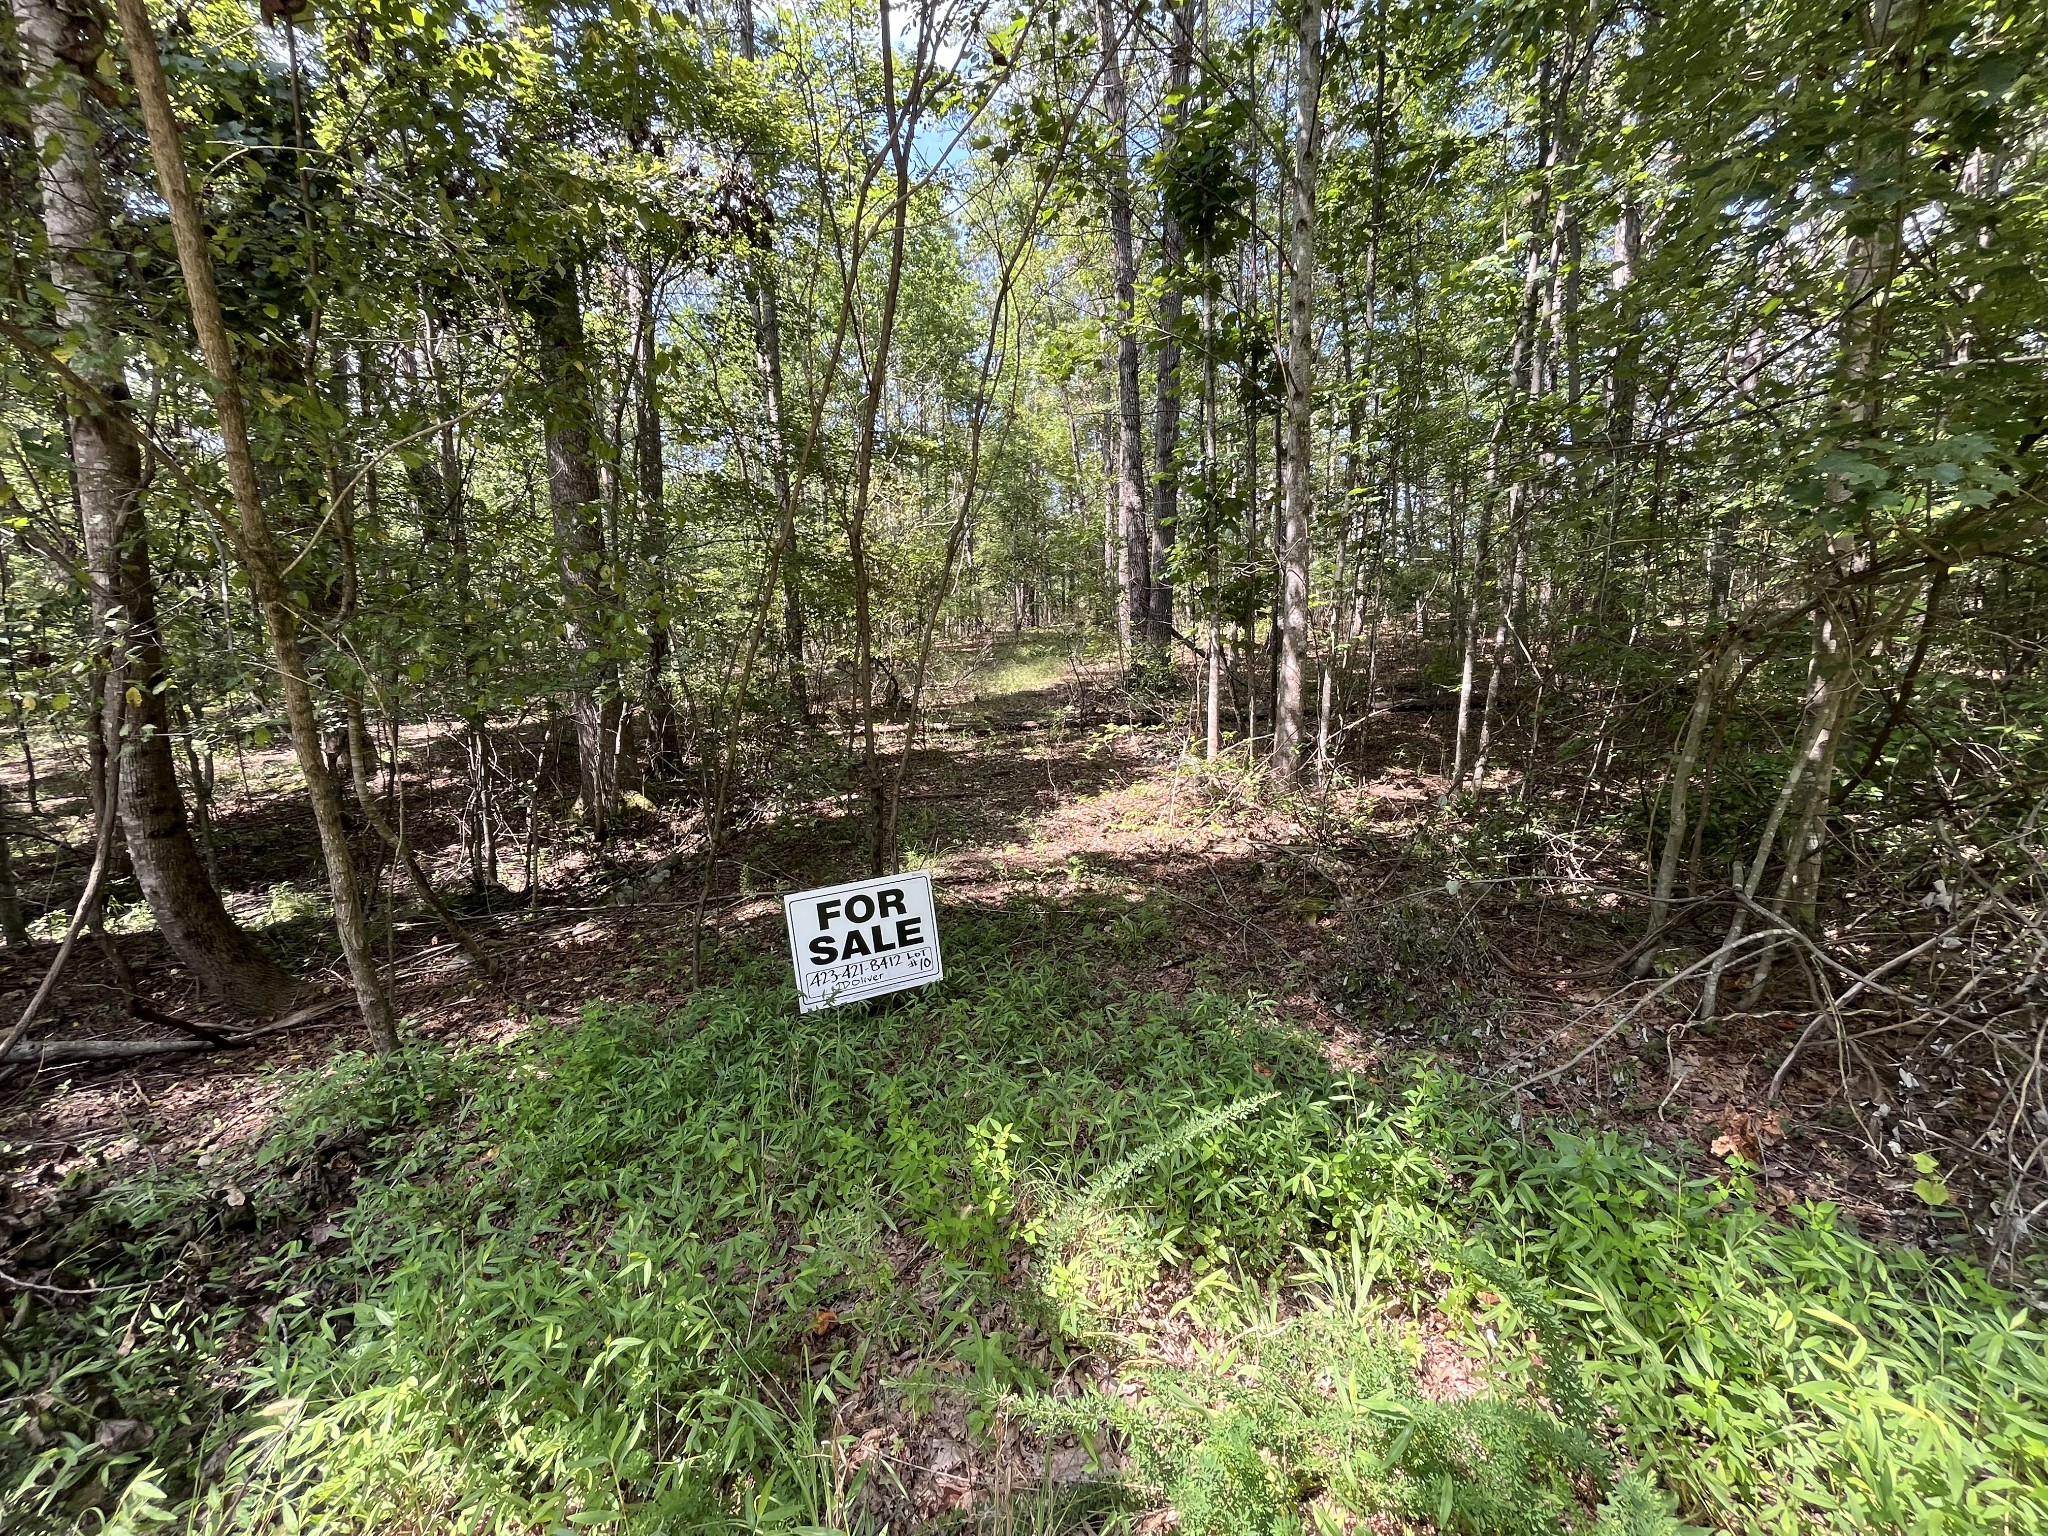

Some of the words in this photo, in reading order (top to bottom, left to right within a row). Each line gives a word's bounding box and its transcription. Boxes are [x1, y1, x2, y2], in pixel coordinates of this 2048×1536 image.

[816, 888, 907, 931] FOR
[808, 916, 924, 966] SALE
[809, 954, 903, 987] 423-421-8412
